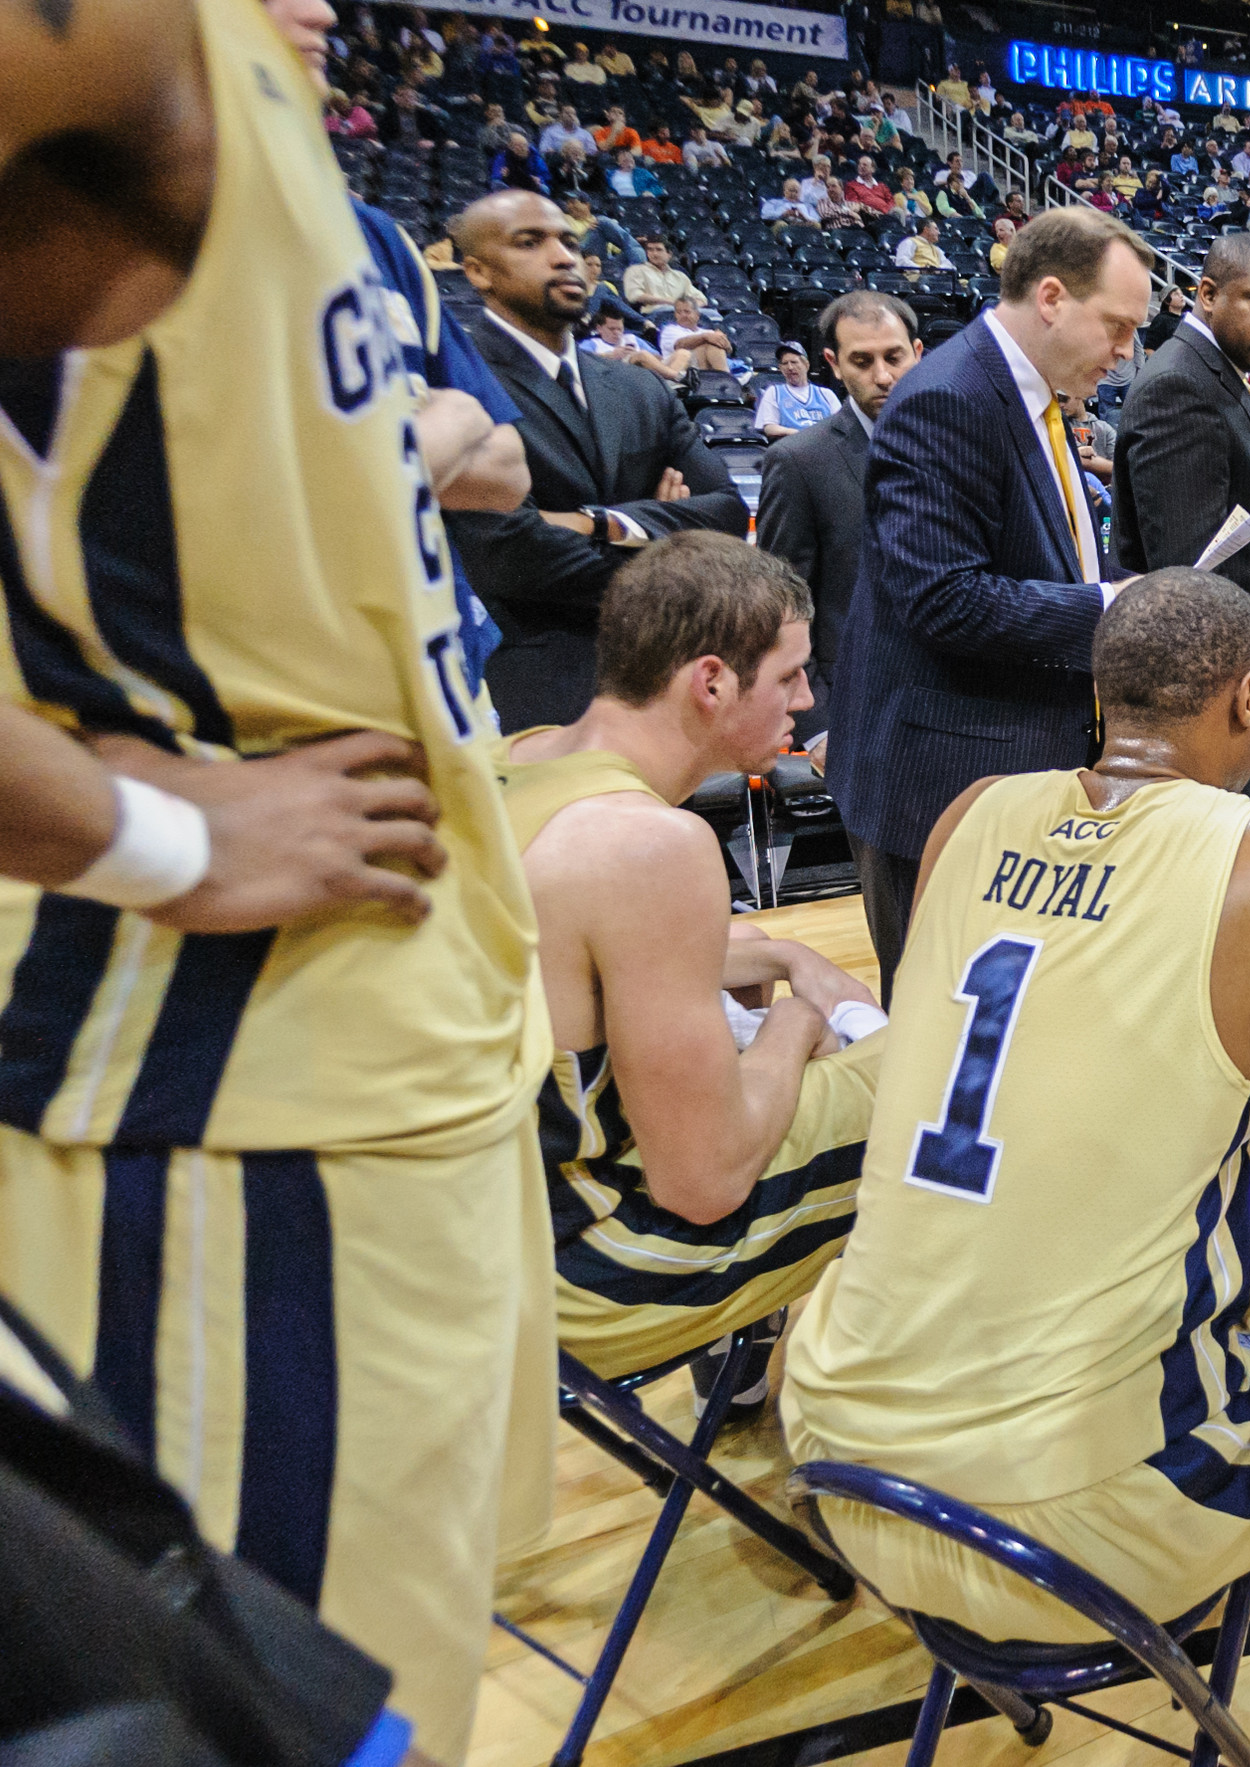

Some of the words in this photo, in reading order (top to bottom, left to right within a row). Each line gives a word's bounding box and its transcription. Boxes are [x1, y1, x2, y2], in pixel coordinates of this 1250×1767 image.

[608, 0, 823, 46] Tournament
[1009, 39, 1176, 102] PHILIPS
[1048, 818, 1120, 840] ACC
[982, 849, 1117, 922] ROYAL
[904, 931, 1045, 1205] 1
